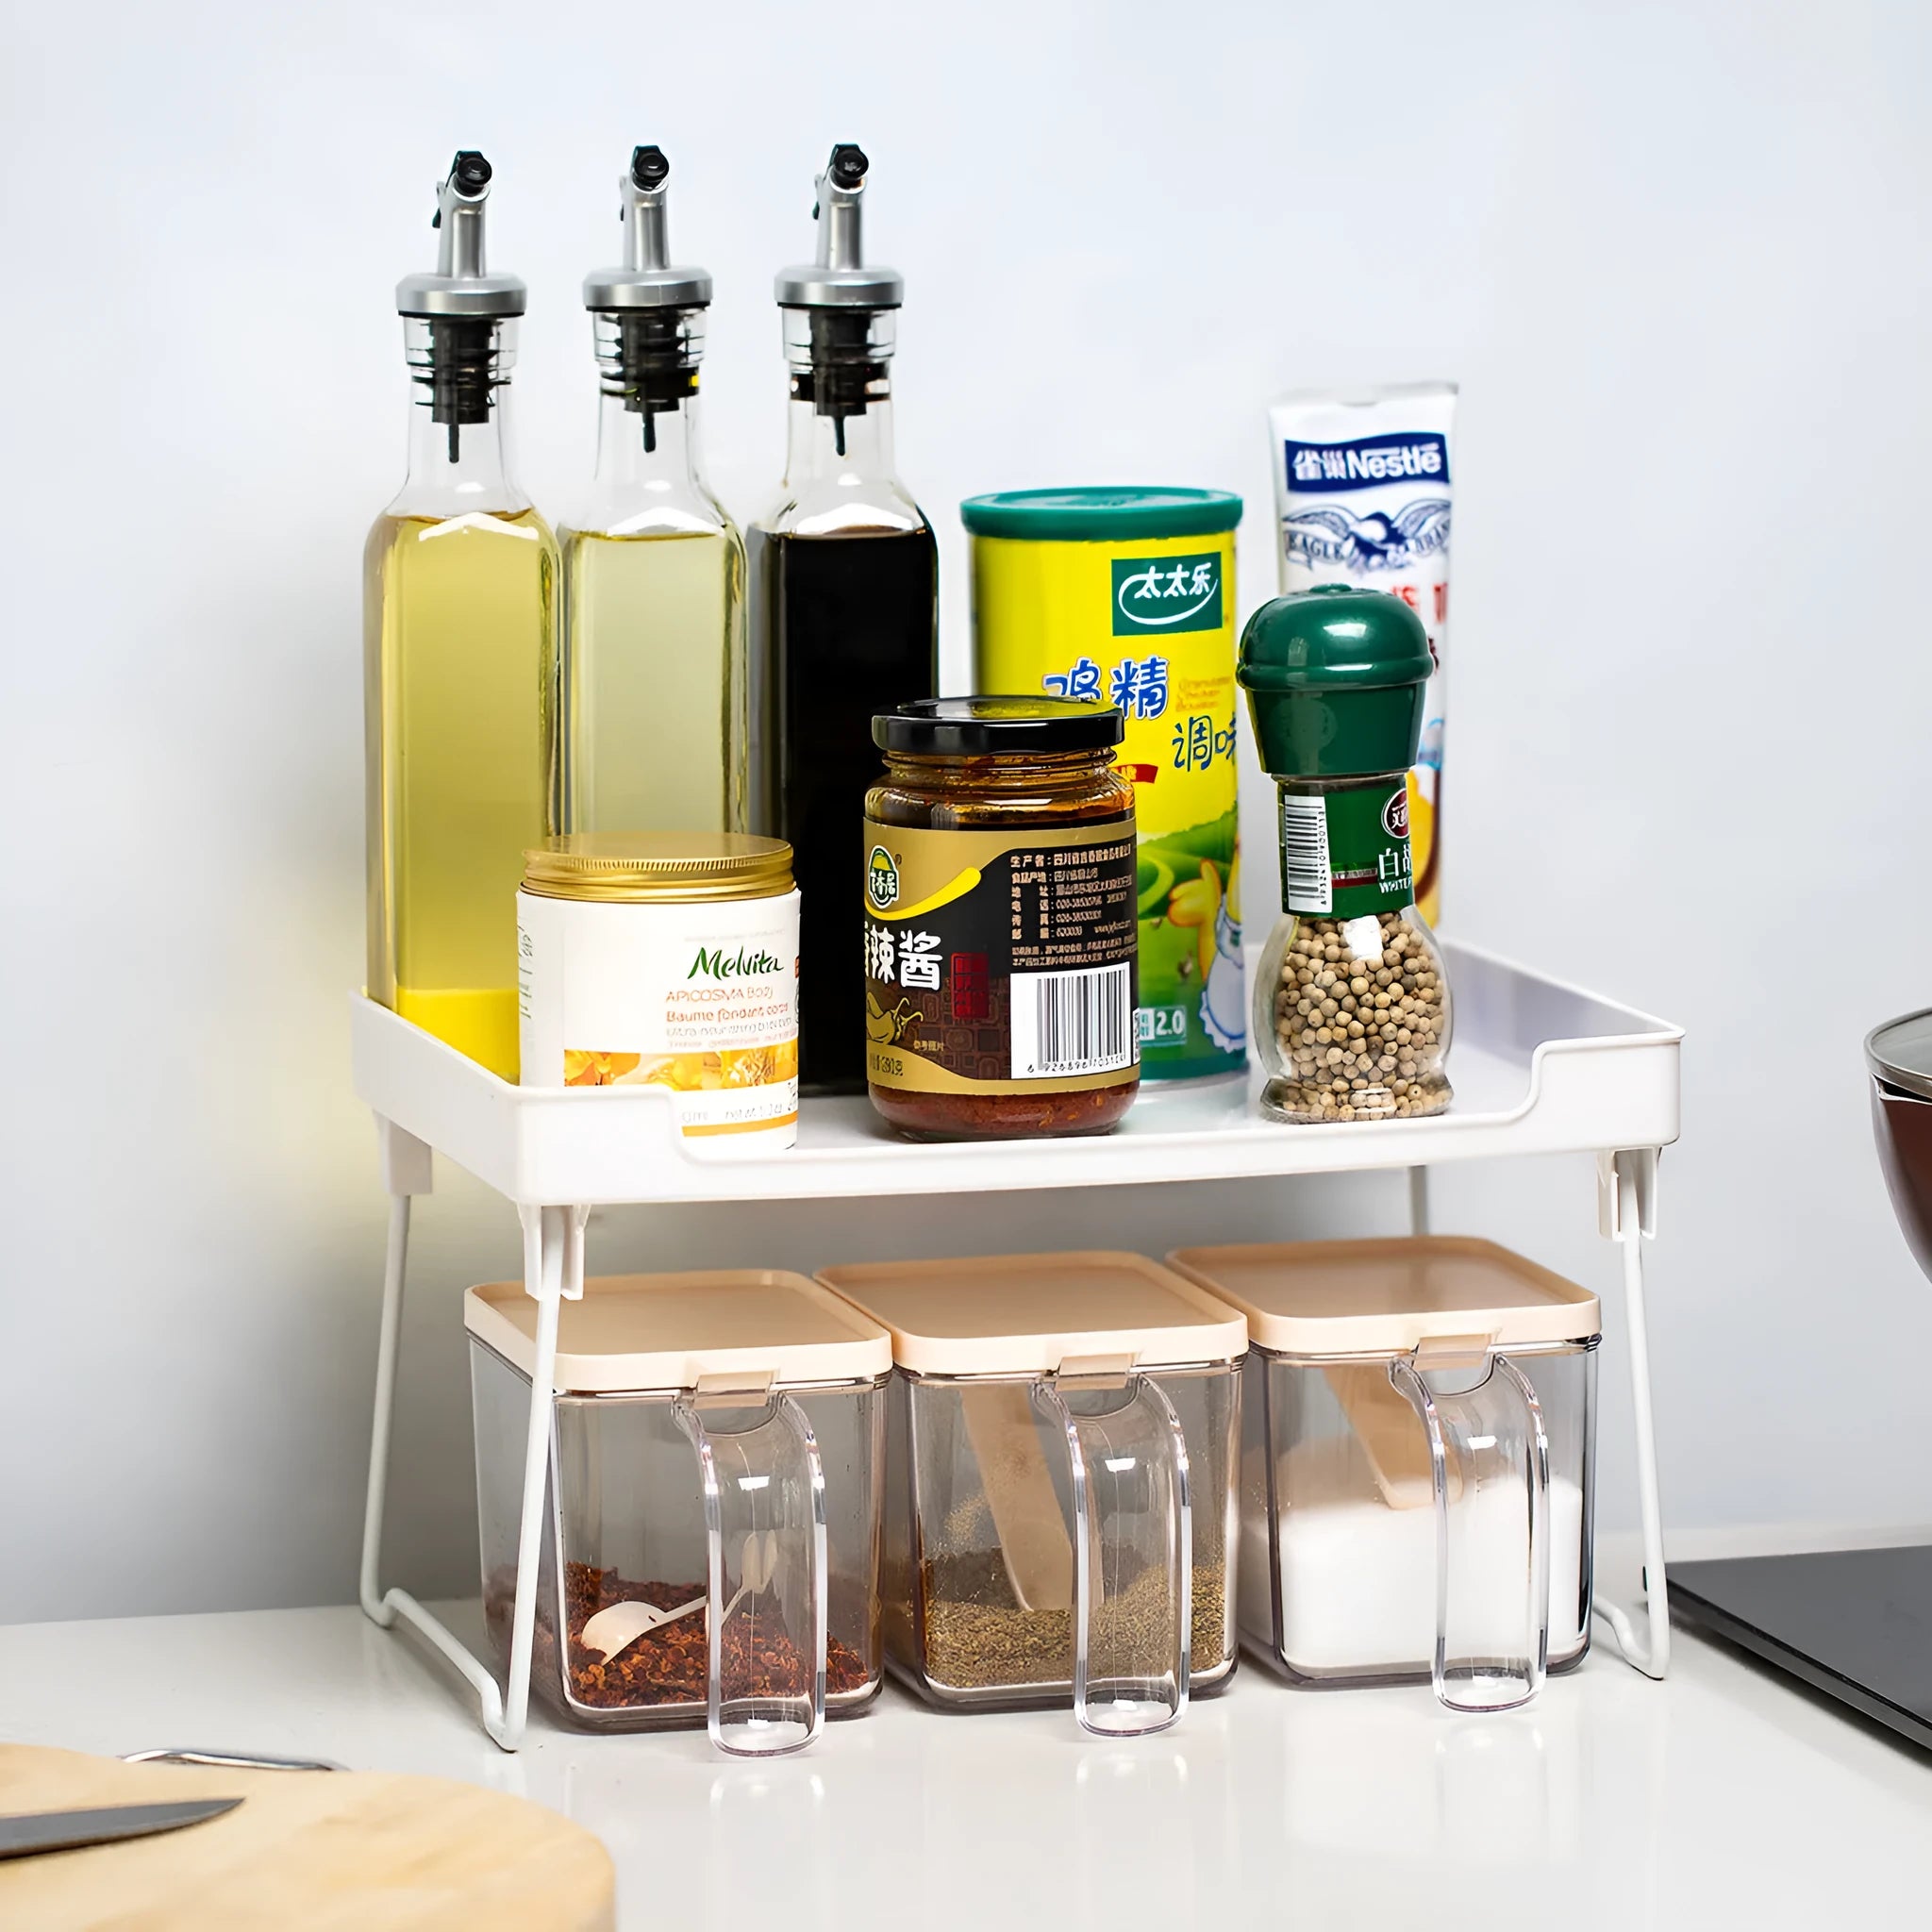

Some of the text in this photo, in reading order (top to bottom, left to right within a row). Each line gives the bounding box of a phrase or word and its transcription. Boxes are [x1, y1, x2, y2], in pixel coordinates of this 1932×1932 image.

[1134, 562, 1212, 599] 太太乐
[687, 945, 784, 980] Melvita
[1156, 1009, 1185, 1036] 2.0
